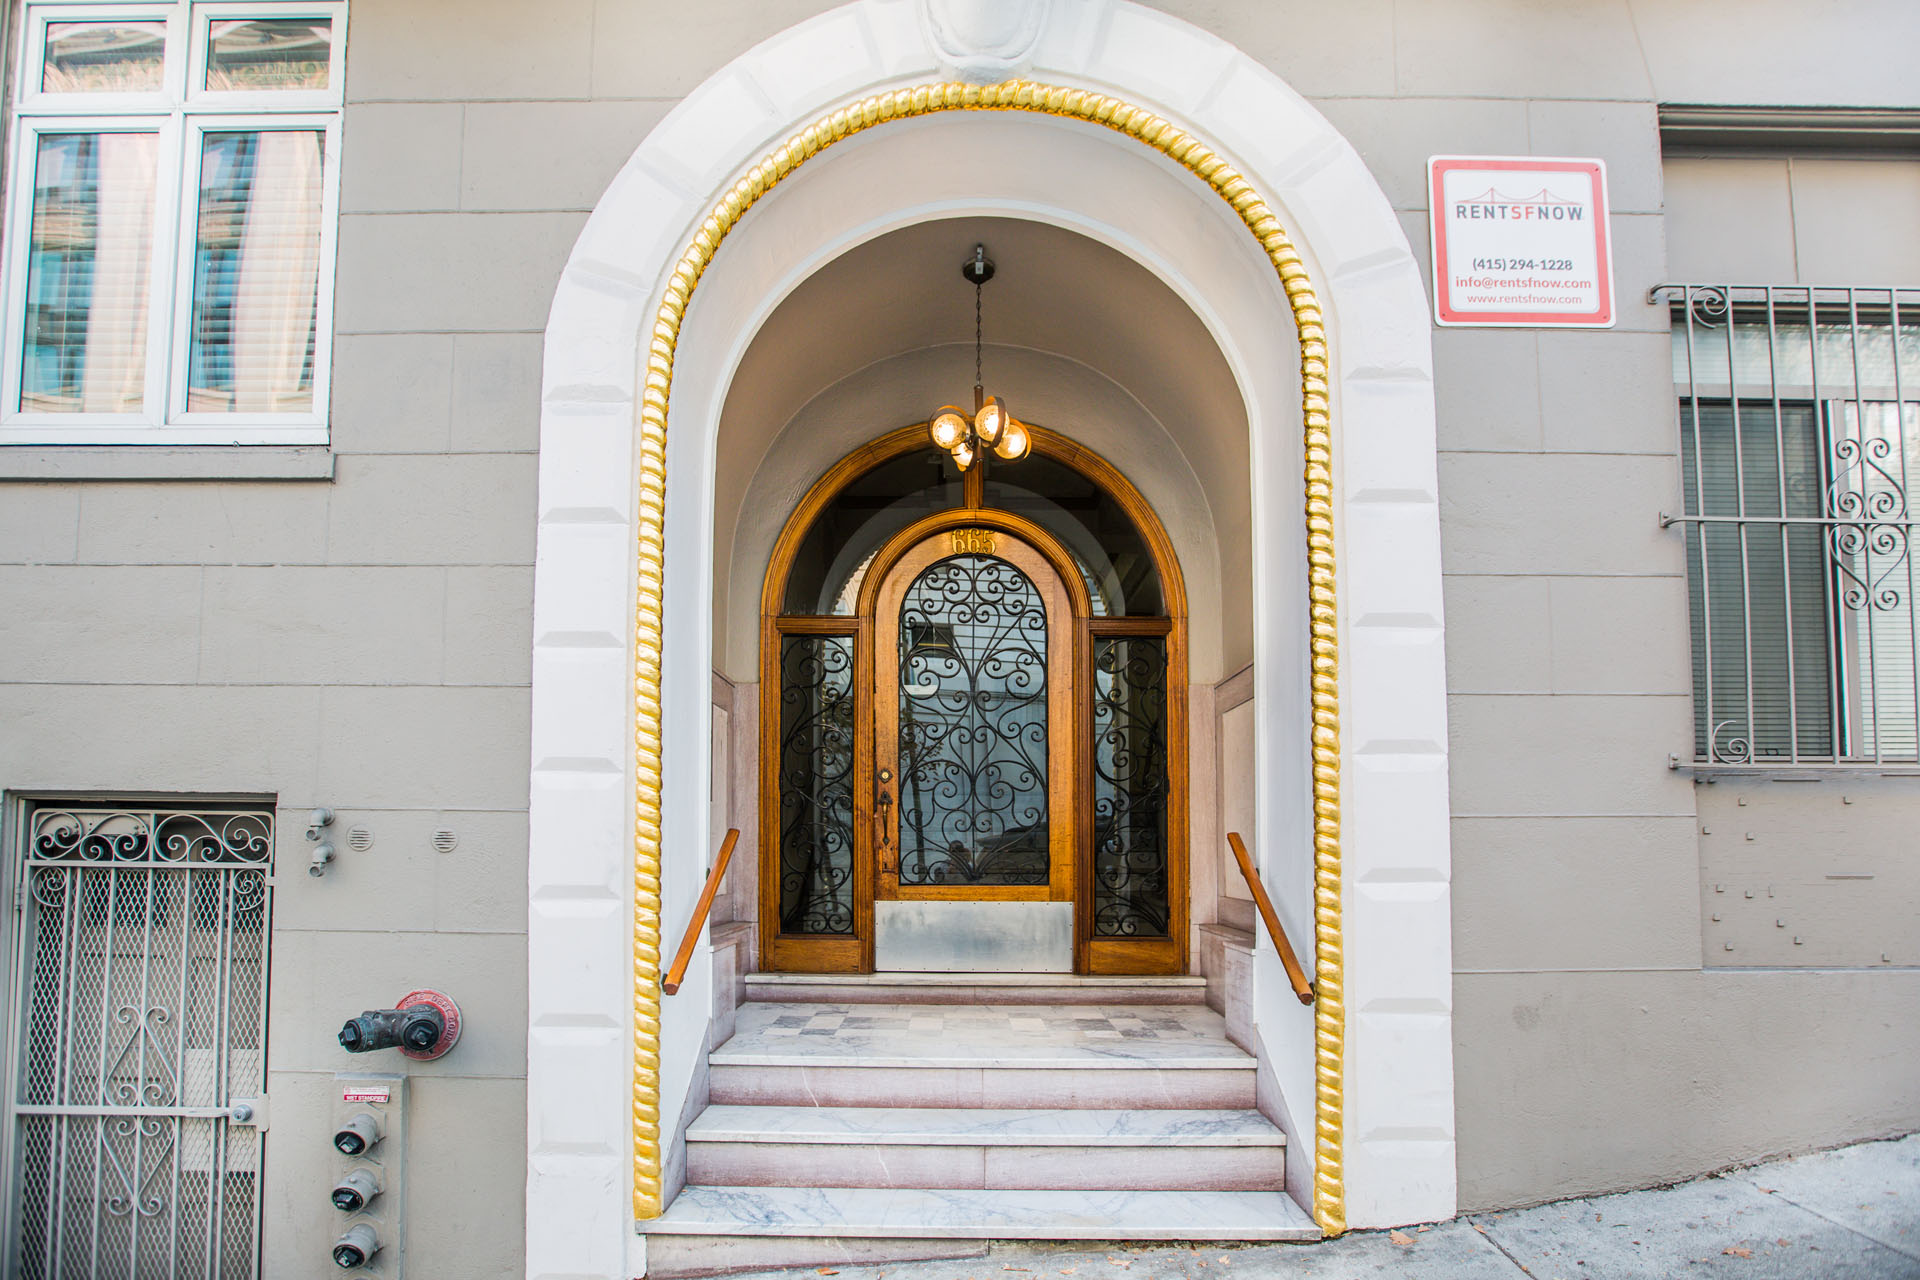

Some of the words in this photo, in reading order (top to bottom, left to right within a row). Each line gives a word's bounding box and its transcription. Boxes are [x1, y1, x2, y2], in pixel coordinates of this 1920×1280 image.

[1456, 205, 1583, 221] RENTSFNOW
[1472, 258, 1506, 271] (415)
[1510, 259, 1573, 271] 294-1228
[1456, 276, 1592, 289] info@rentsfnow.com
[1467, 294, 1582, 304] www.rentsfnow.com
[952, 528, 996, 555] 665
